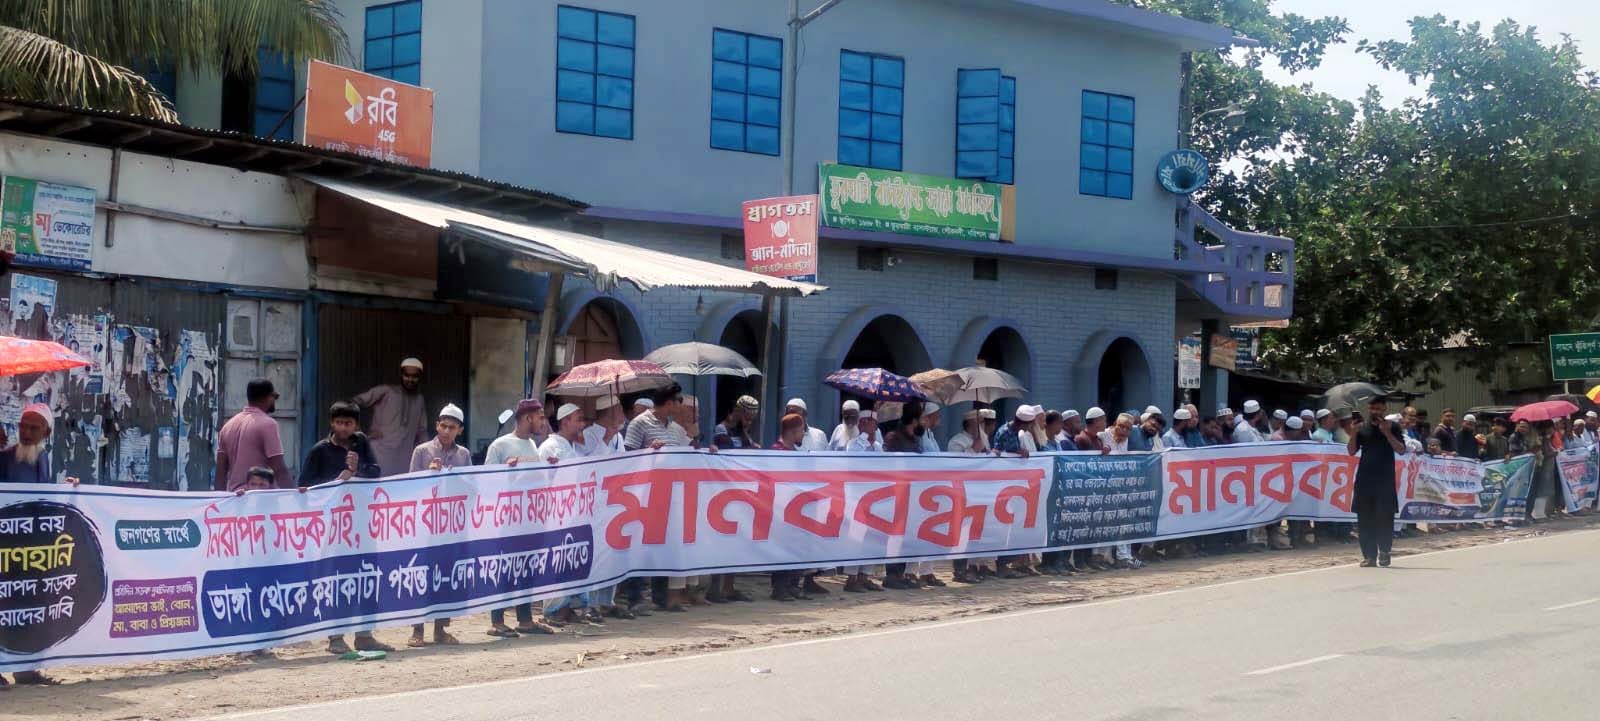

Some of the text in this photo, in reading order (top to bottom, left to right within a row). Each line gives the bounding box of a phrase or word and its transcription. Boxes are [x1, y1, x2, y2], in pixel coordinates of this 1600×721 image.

[367, 87, 398, 127] রবি
[204, 470, 597, 559] নিরাপদ সড়ক চাই, জীবন বাঁচাতে ৬-লেন মহাসড়ক চাই
[601, 468, 1046, 550] মানববন্ধন
[0, 515, 66, 535] আর নয়
[119, 521, 190, 544] জনগণের স্বার্থে
[0, 534, 75, 573] াণহানি
[0, 574, 78, 598] রাপদ সড়ক
[207, 533, 590, 623] ভাঙ্গা থেকে কুয়াকাটা পর্যন্ত ৬-লেন মহাসড়কের দাবিতে
[0, 595, 75, 626] মাদের দাবি
[114, 599, 194, 614] আমাদের ভাই, বোন,
[130, 619, 148, 631] বাবা
[151, 619, 157, 630] ও
